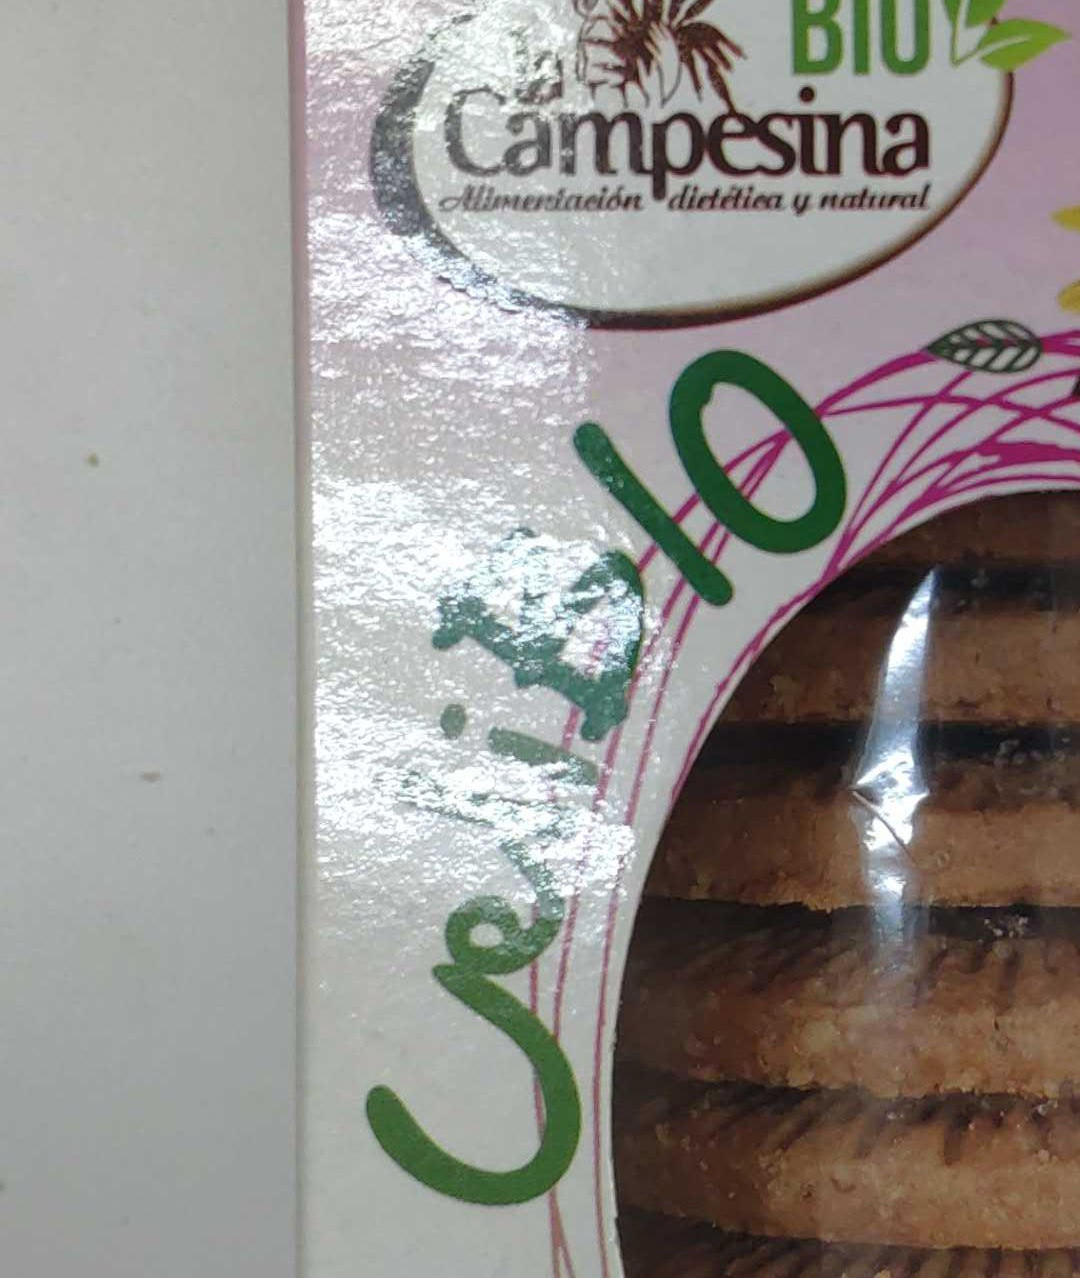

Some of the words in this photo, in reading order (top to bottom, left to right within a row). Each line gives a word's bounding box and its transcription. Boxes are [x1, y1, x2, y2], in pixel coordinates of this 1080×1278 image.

[444, 84, 932, 201] Campesina
[438, 182, 643, 213] Alimentación
[667, 183, 783, 212] dietética
[791, 192, 811, 216] y
[819, 183, 932, 211] natural
